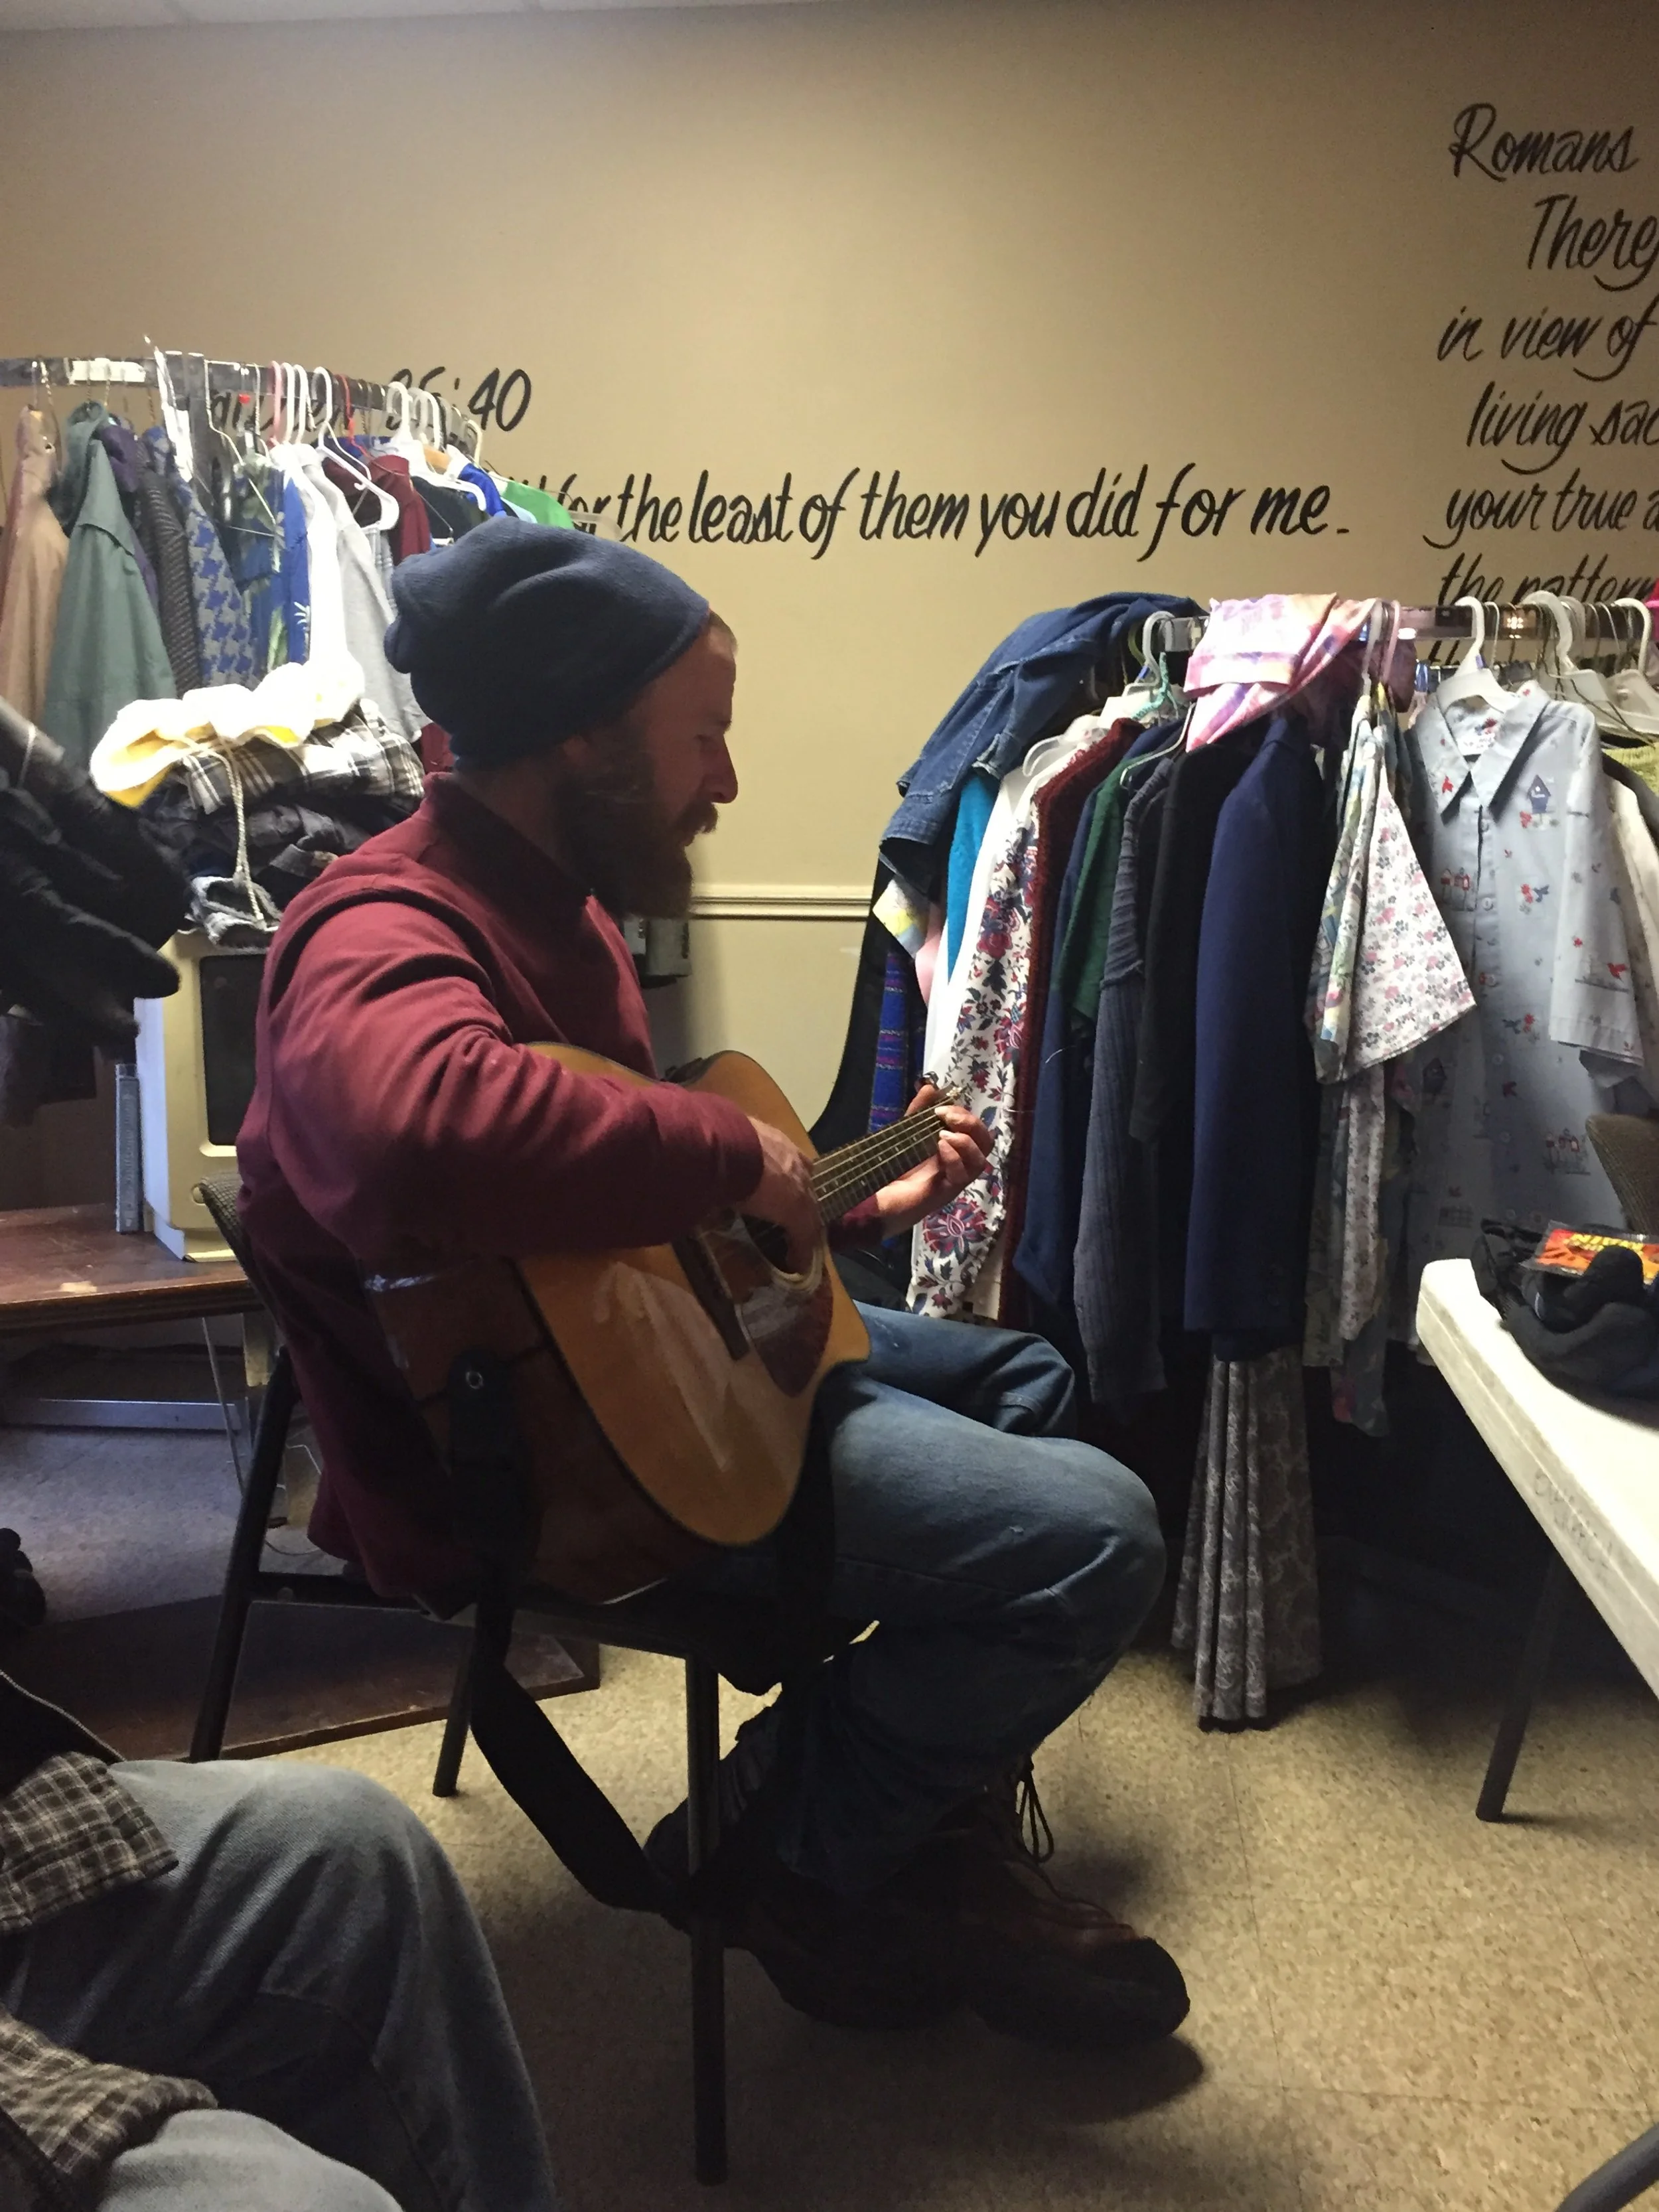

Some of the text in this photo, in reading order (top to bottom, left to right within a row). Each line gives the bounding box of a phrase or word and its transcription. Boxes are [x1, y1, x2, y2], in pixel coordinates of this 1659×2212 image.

[1448, 102, 1640, 183] Romans
[1437, 293, 1659, 382] in view of
[1466, 381, 1588, 475] living
[616, 473, 683, 543] the
[688, 469, 794, 544] least
[798, 467, 860, 561] of
[859, 469, 970, 541] them
[974, 490, 1061, 558] you
[1066, 463, 1149, 538] did
[1136, 462, 1246, 563] for
[1422, 482, 1548, 550] your
[1552, 467, 1638, 532] true
[1437, 552, 1504, 607] the
